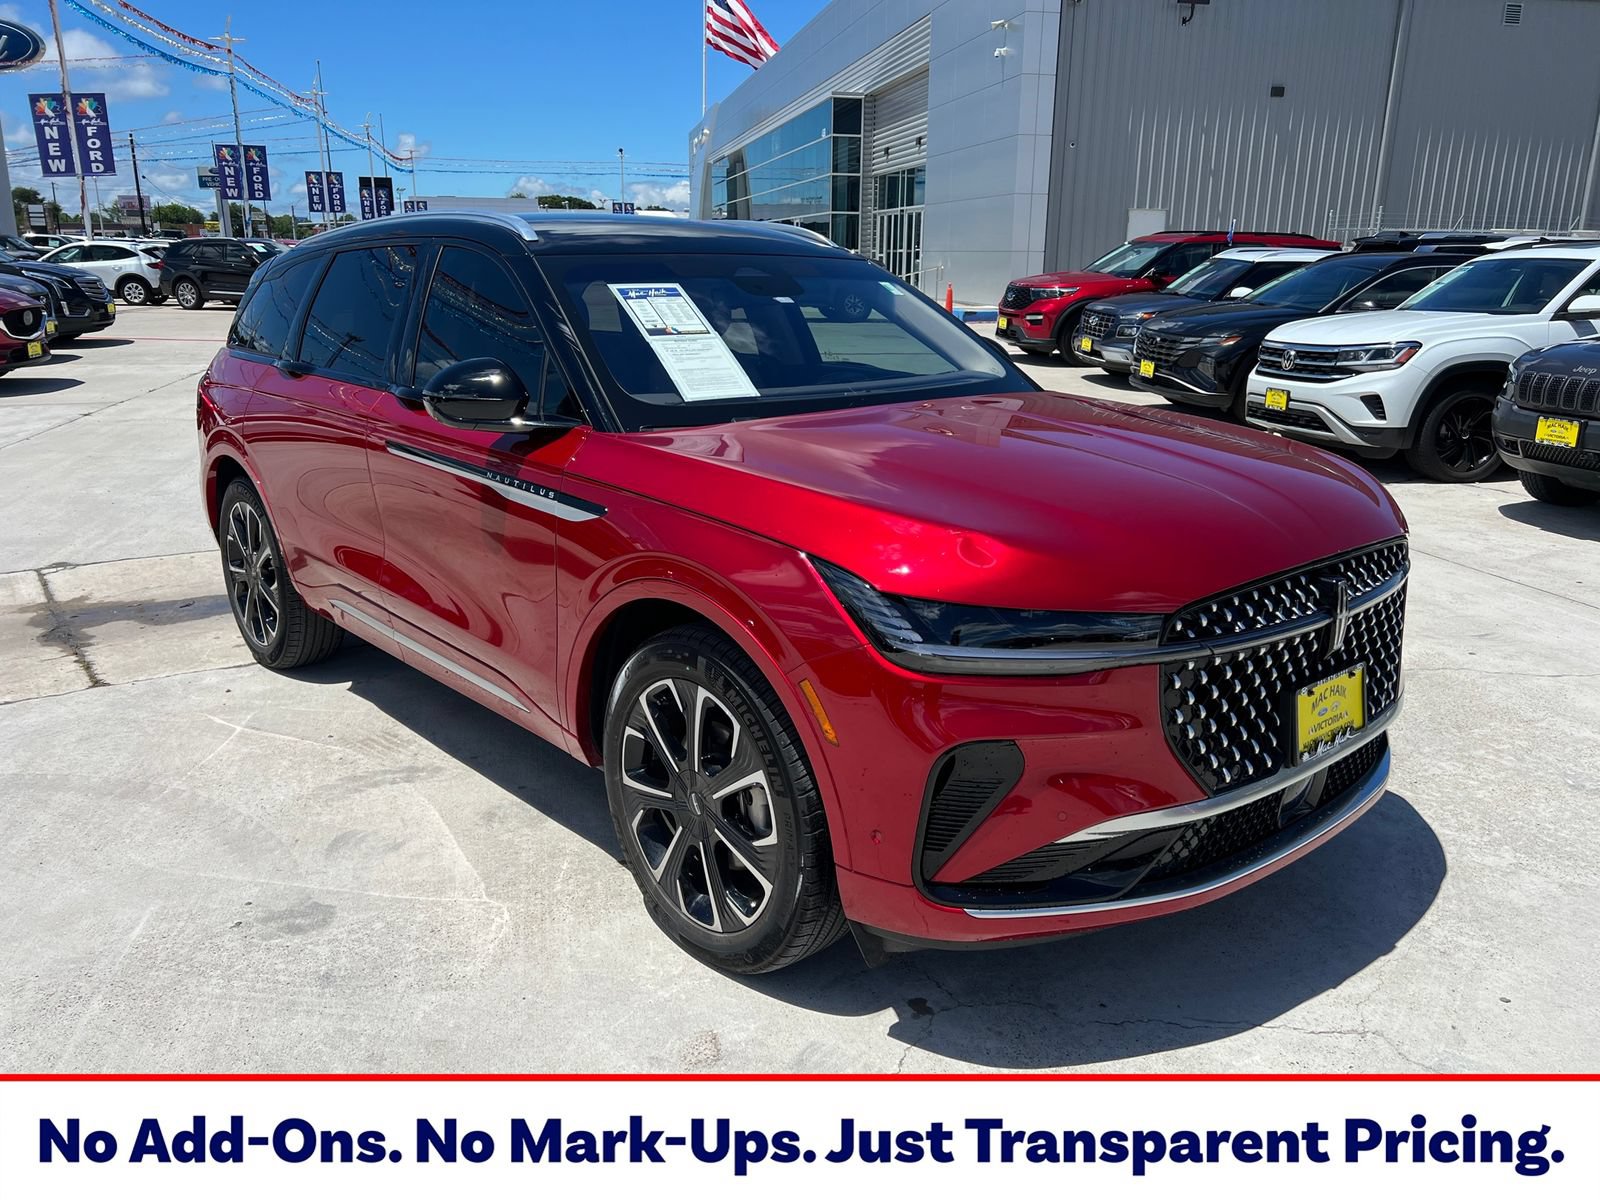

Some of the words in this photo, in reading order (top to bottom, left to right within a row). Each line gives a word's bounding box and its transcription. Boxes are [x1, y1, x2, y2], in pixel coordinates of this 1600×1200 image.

[43, 126, 66, 172] NEW
[86, 126, 105, 173] FORD
[224, 166, 239, 198] NEW
[252, 167, 264, 198] FORD
[312, 187, 322, 211] NEW
[332, 187, 341, 211] FORD
[363, 200, 373, 219] NEW
[1572, 365, 1598, 375] Jeep
[486, 471, 555, 499] NAUTILUS
[1311, 688, 1329, 713] MAC
[1329, 684, 1347, 699] HAIK
[1312, 712, 1344, 733] VICTORIA
[726, 688, 786, 797] MICHELIN
